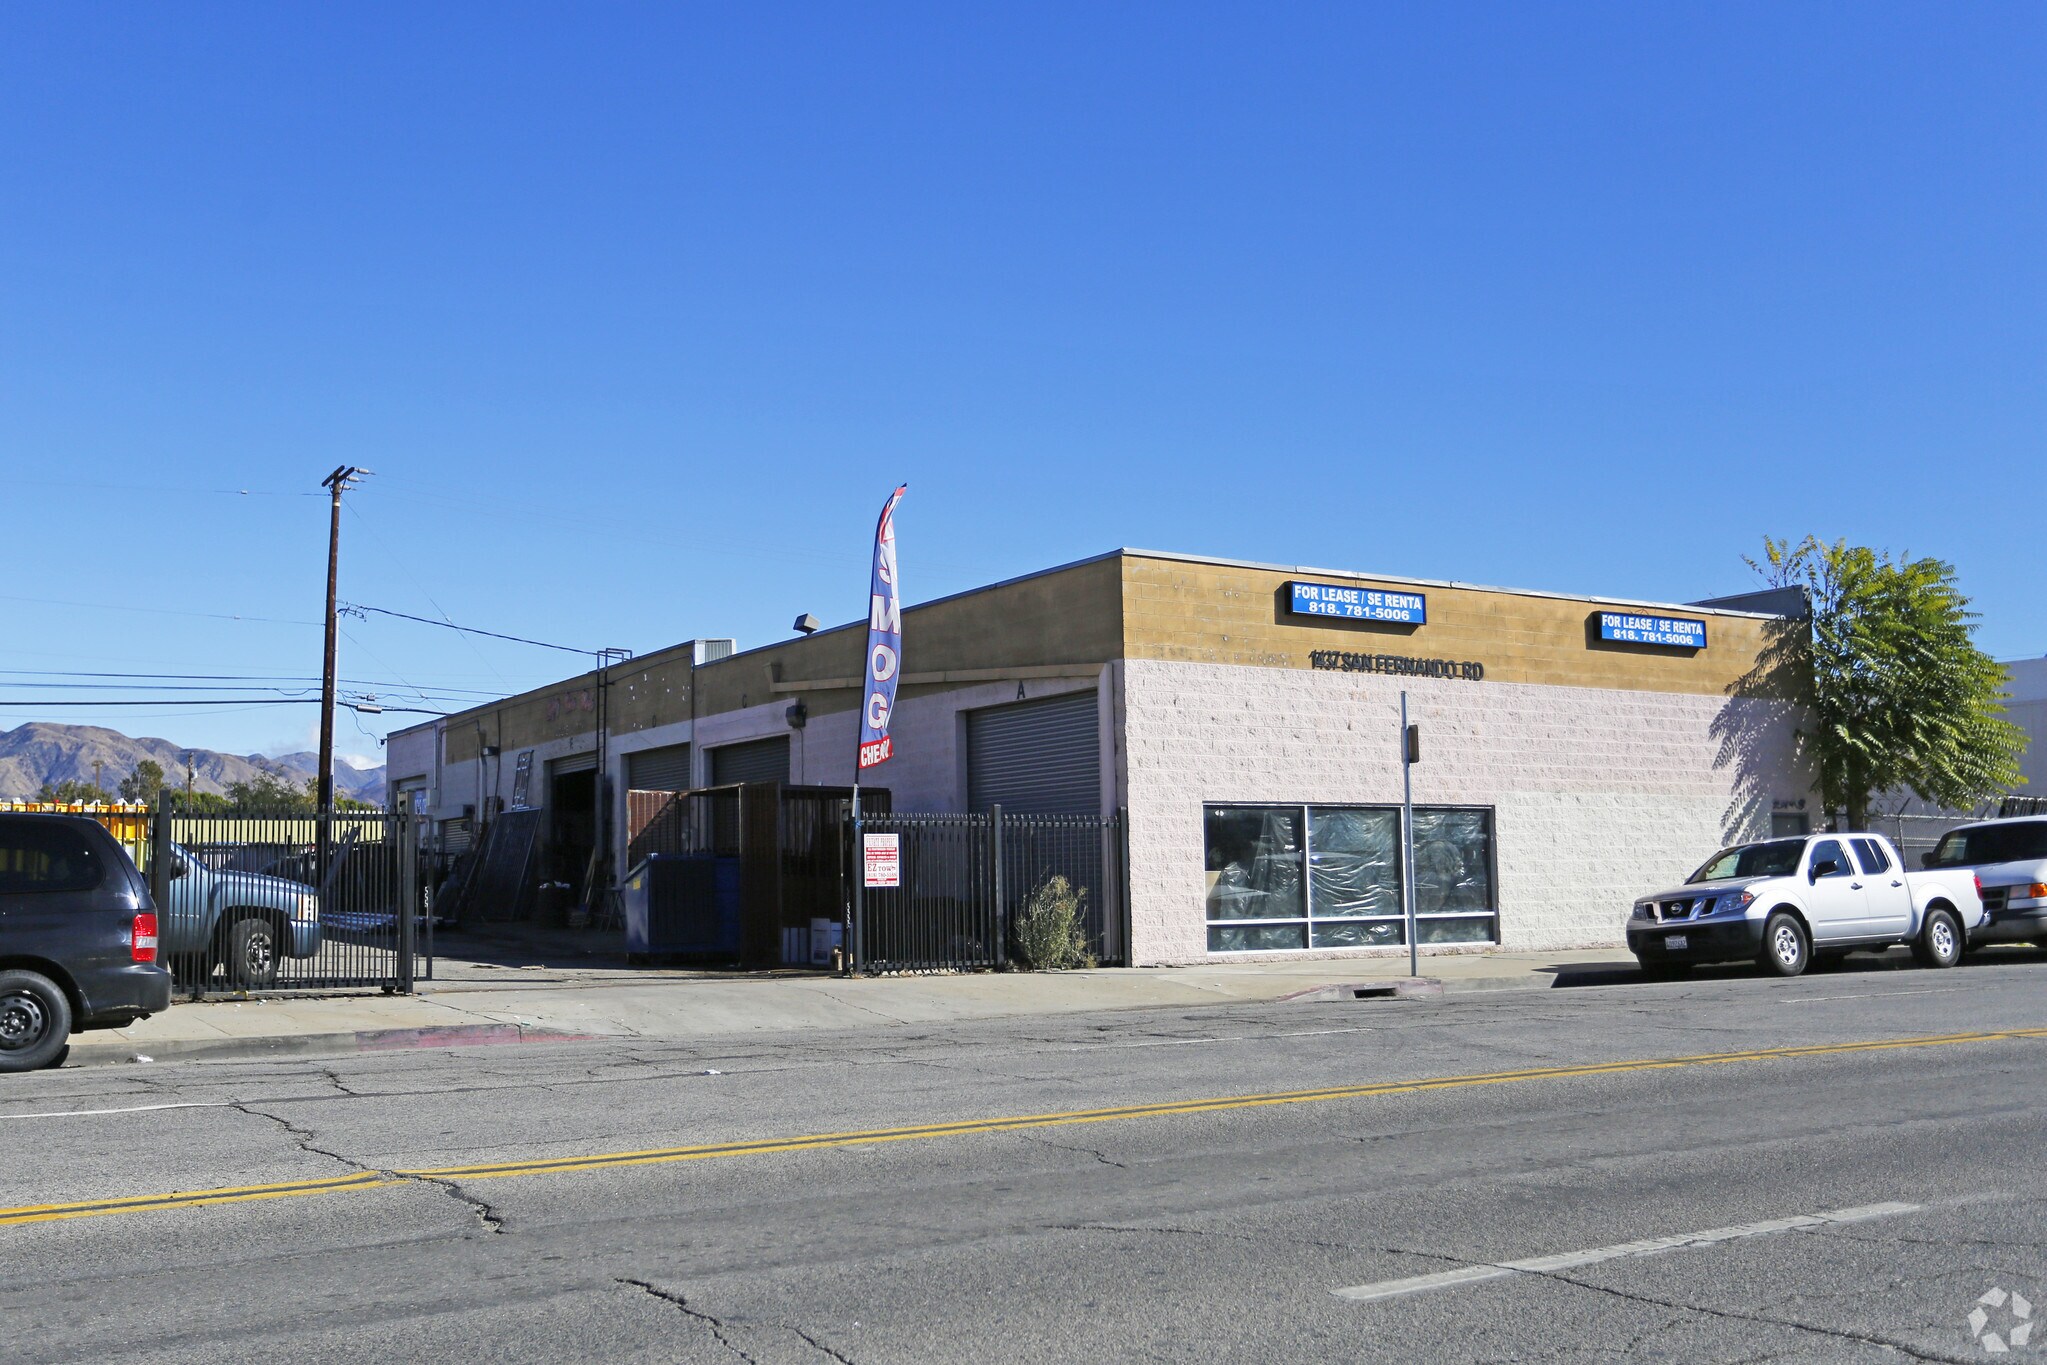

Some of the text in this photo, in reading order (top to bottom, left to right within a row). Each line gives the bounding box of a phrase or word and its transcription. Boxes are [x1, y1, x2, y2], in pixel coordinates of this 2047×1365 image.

[1294, 585, 1318, 600] FOR
[1321, 588, 1358, 604] LEASE
[1367, 592, 1382, 606] SE
[1385, 594, 1422, 610] RENTA
[1308, 602, 1410, 621] 818. 781-5006
[1601, 614, 1621, 627] FOR
[1623, 616, 1652, 631] LEASE
[1658, 620, 1671, 633] SE
[1673, 622, 1703, 635] RENTA
[1613, 629, 1694, 645] 818. 781-5006
[1309, 649, 1485, 681] 1437 SAN FERNANDO RD
[1017, 680, 1025, 699] A
[867, 863, 877, 872] EZ
